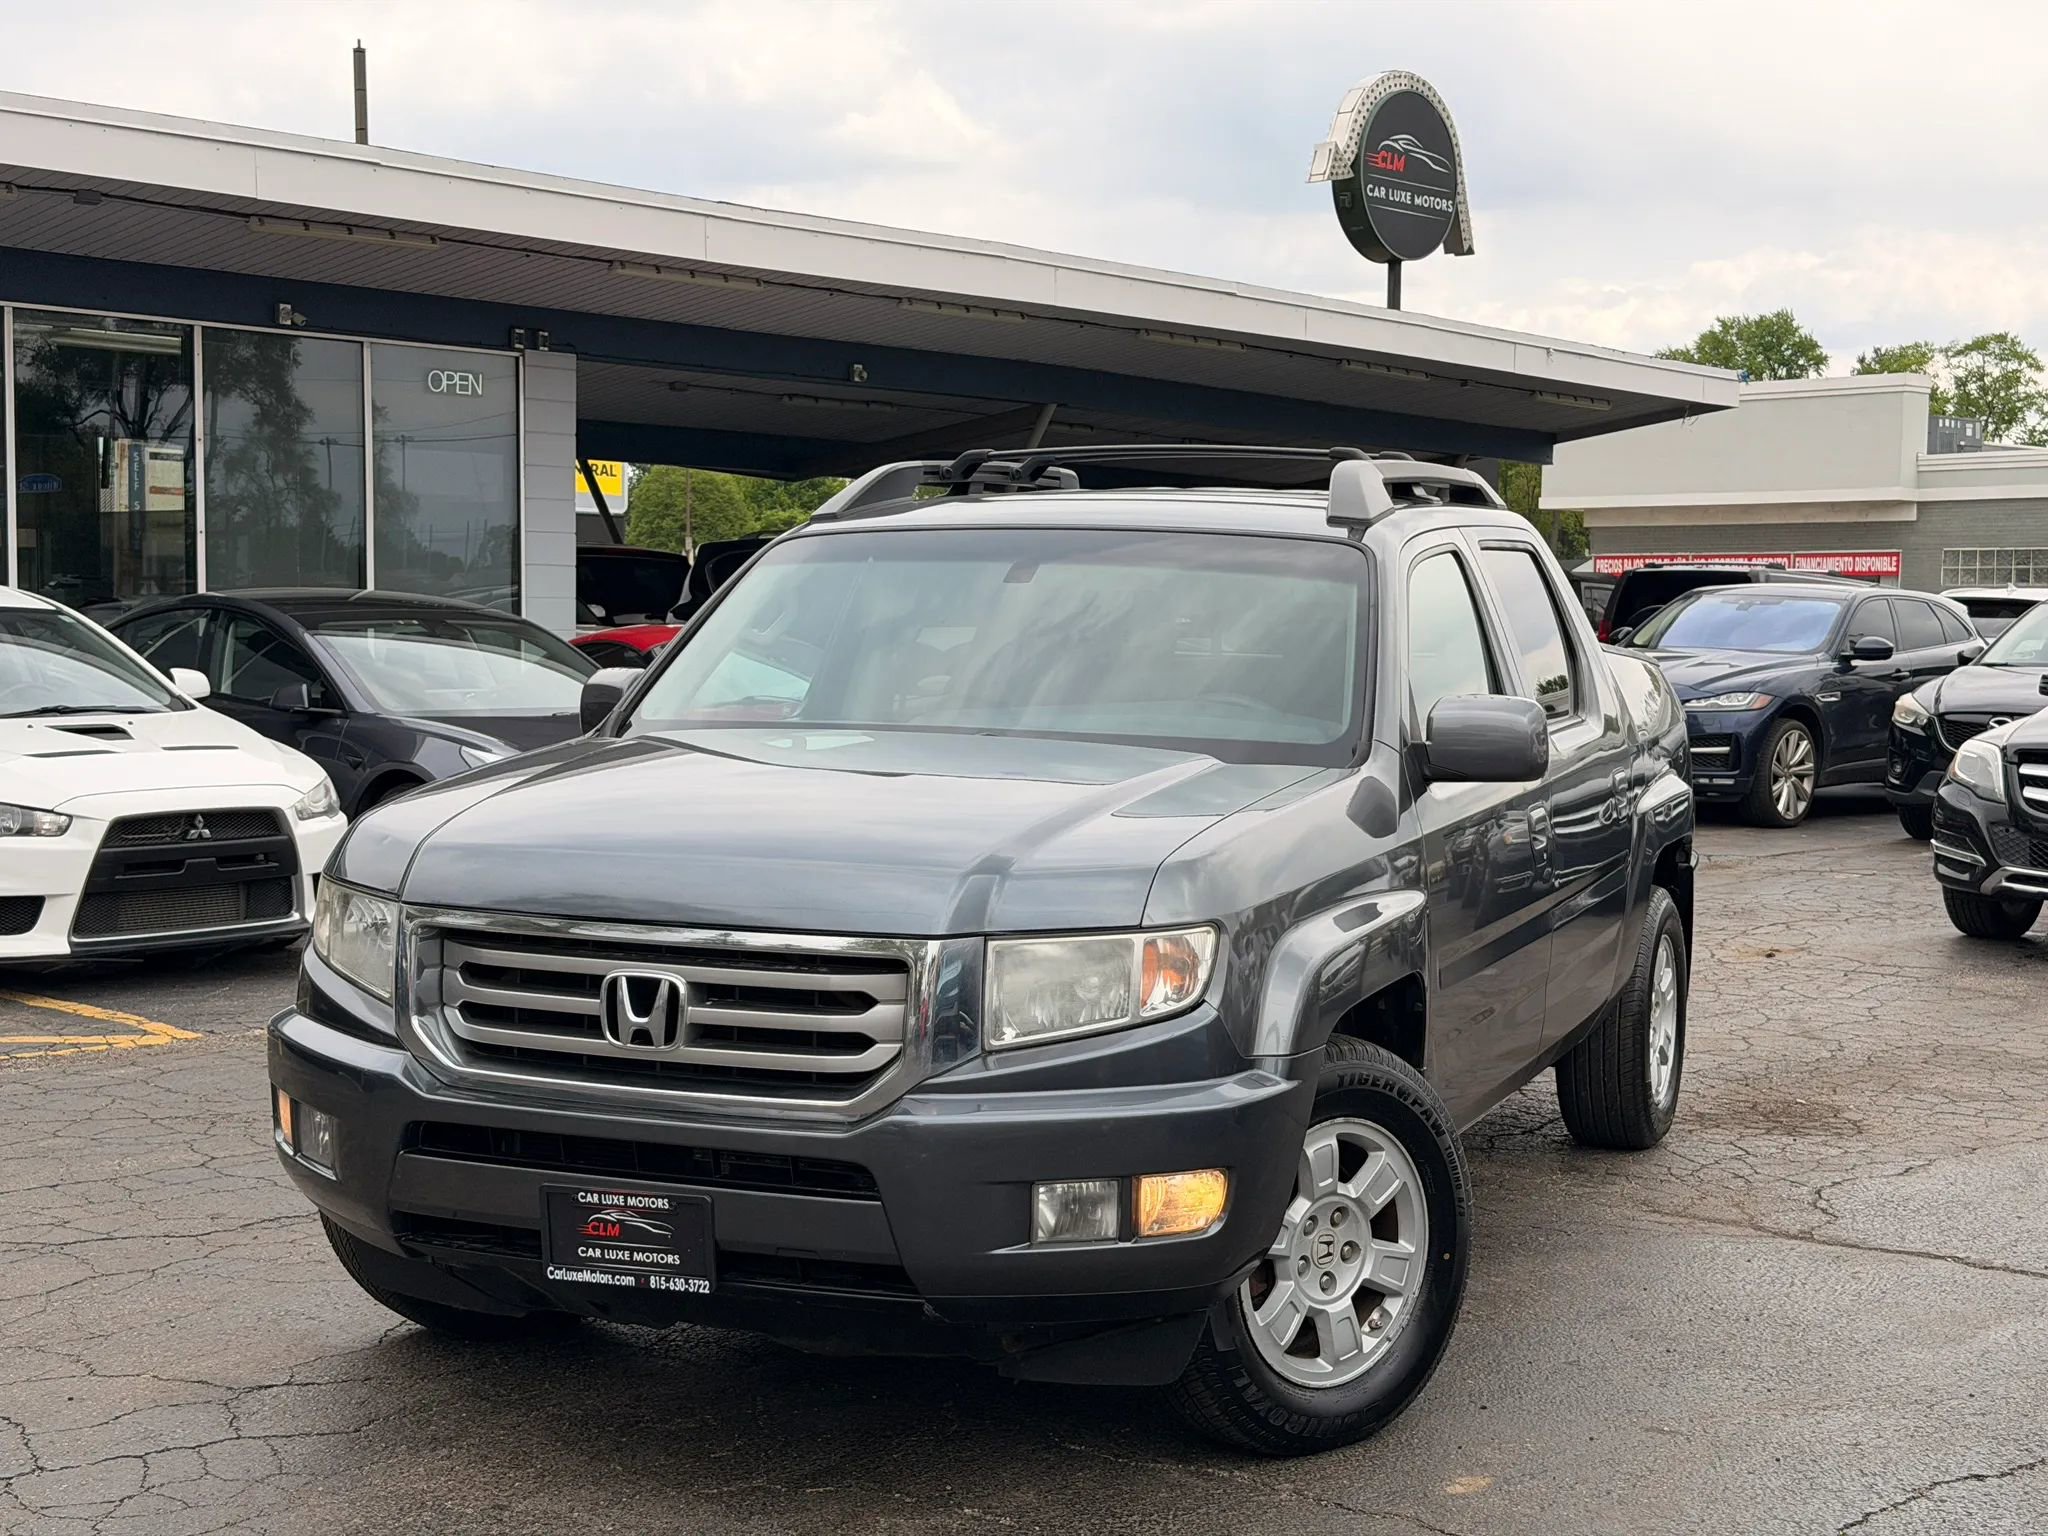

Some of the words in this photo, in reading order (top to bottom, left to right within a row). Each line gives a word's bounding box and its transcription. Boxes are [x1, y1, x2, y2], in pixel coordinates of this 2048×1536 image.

[1377, 150, 1407, 172] CLM
[1366, 184, 1386, 198] CAR
[1389, 188, 1412, 205] LUXE
[1414, 193, 1454, 212] MOTORS
[428, 370, 482, 395] OPEN
[1595, 558, 1622, 573] PRECIOS
[1623, 558, 1645, 570] BAJOS
[1795, 556, 1853, 571] FINANCIAMIENTO
[1854, 555, 1897, 571] DISPONIBLE
[1336, 1071, 1397, 1093] TIGER
[1410, 1094, 1446, 1138] PAW
[577, 1191, 599, 1204] CAR
[601, 1193, 625, 1206] LUXE
[627, 1196, 669, 1209] MOTORS
[588, 1221, 621, 1237] CLM
[577, 1246, 602, 1258] CAR
[604, 1249, 631, 1261] LUXE
[633, 1252, 681, 1265] MOTORS
[546, 1266, 635, 1287] CarLuxeMotors.com
[649, 1277, 710, 1294] 815-630-3722
